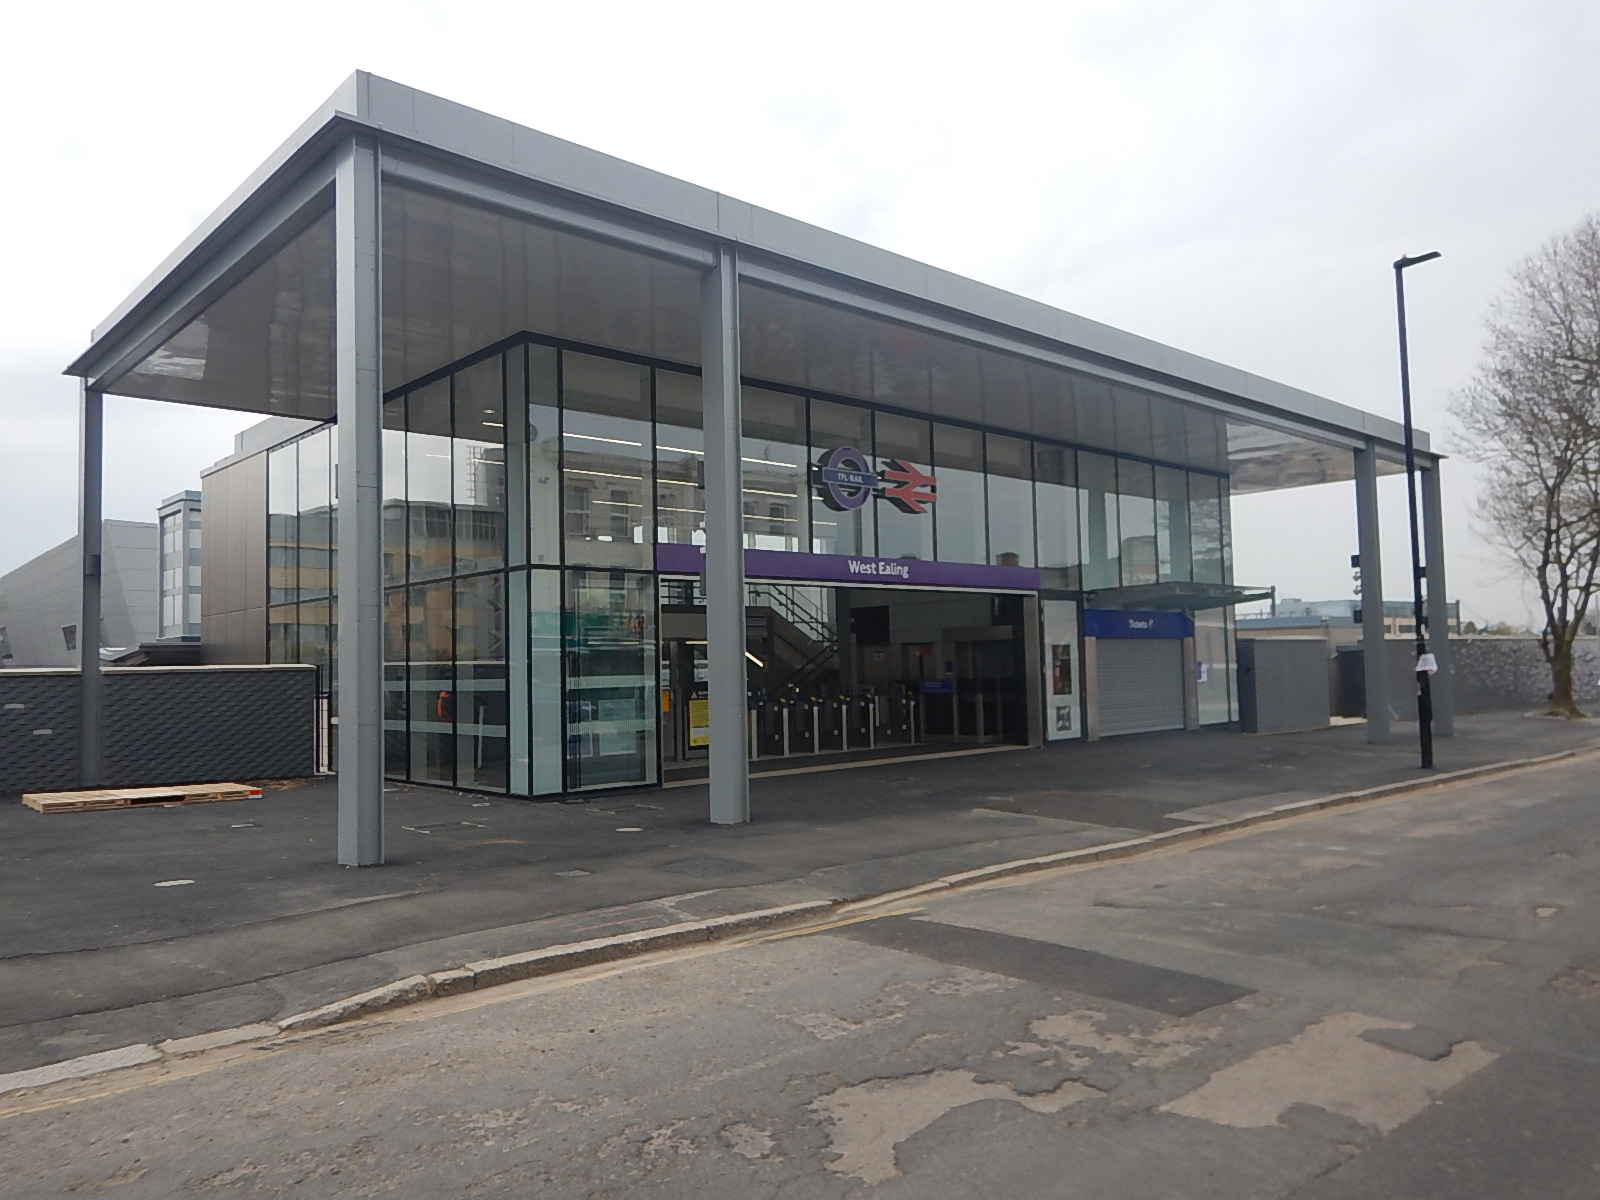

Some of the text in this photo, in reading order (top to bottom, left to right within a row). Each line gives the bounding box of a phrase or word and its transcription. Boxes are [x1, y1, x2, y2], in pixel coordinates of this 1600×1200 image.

[850, 474, 864, 483] RAIL
[847, 559, 909, 579] West Ealing
